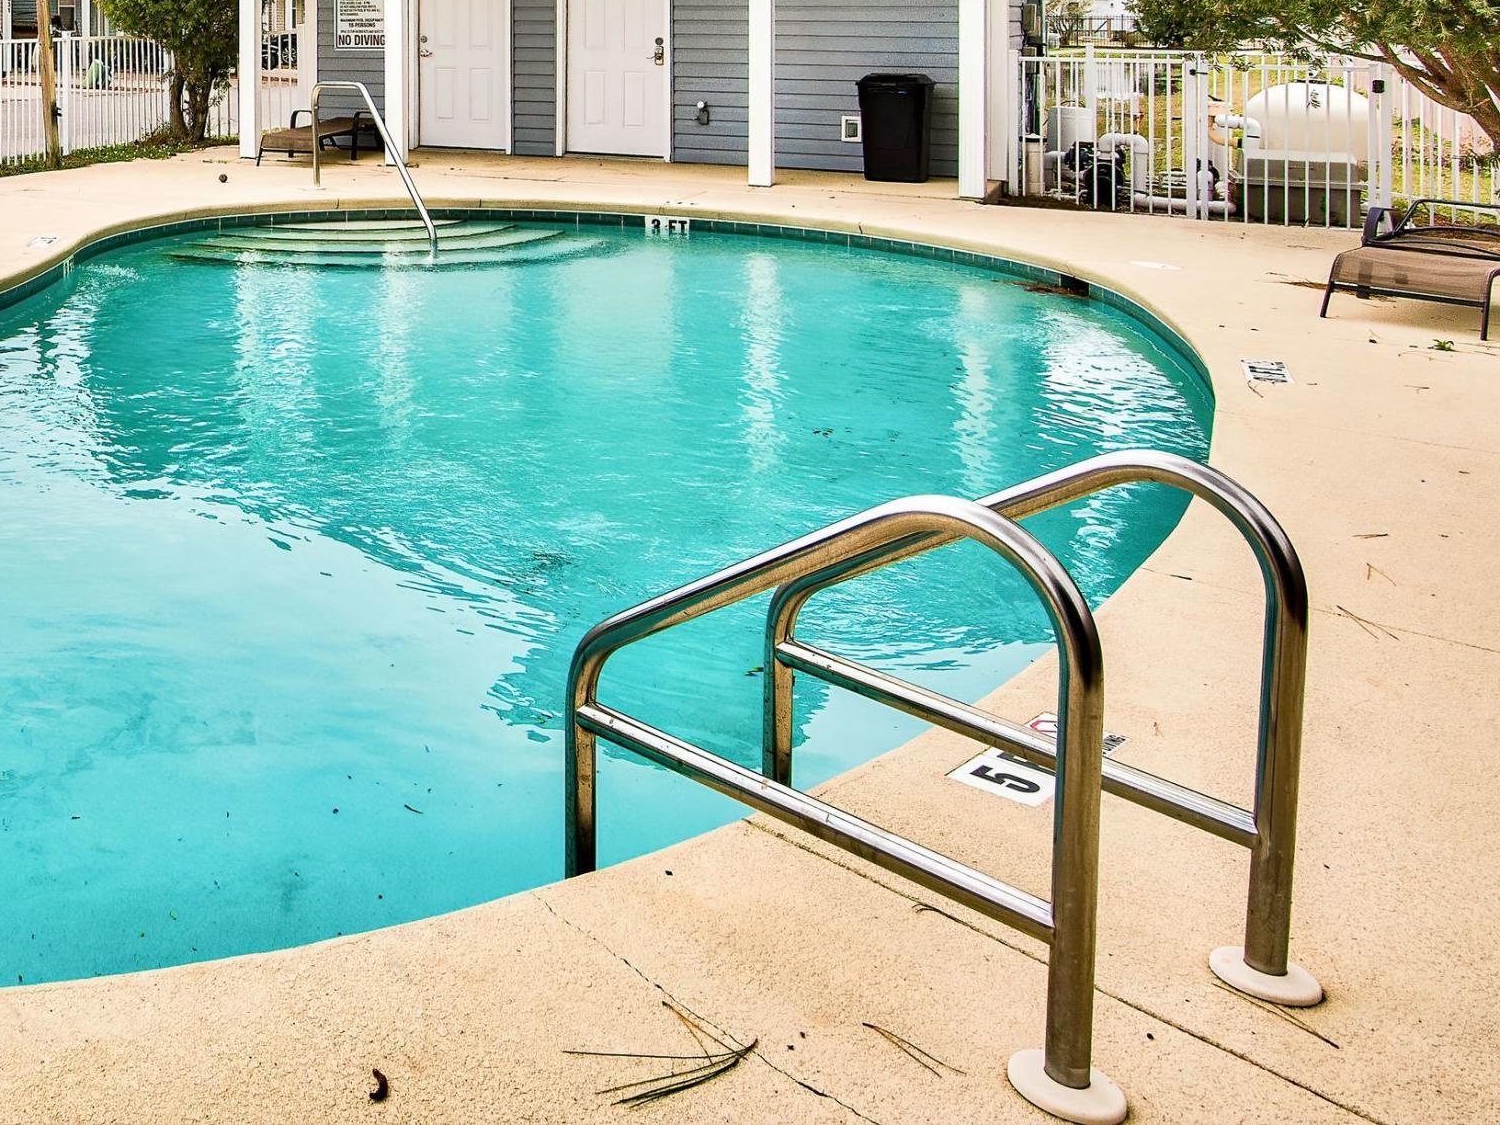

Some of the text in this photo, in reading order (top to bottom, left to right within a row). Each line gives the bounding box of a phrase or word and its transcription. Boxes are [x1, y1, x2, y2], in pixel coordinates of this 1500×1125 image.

[338, 34, 385, 45] NO DIVING
[651, 218, 688, 235] 3 FT
[969, 764, 1041, 794] 5
